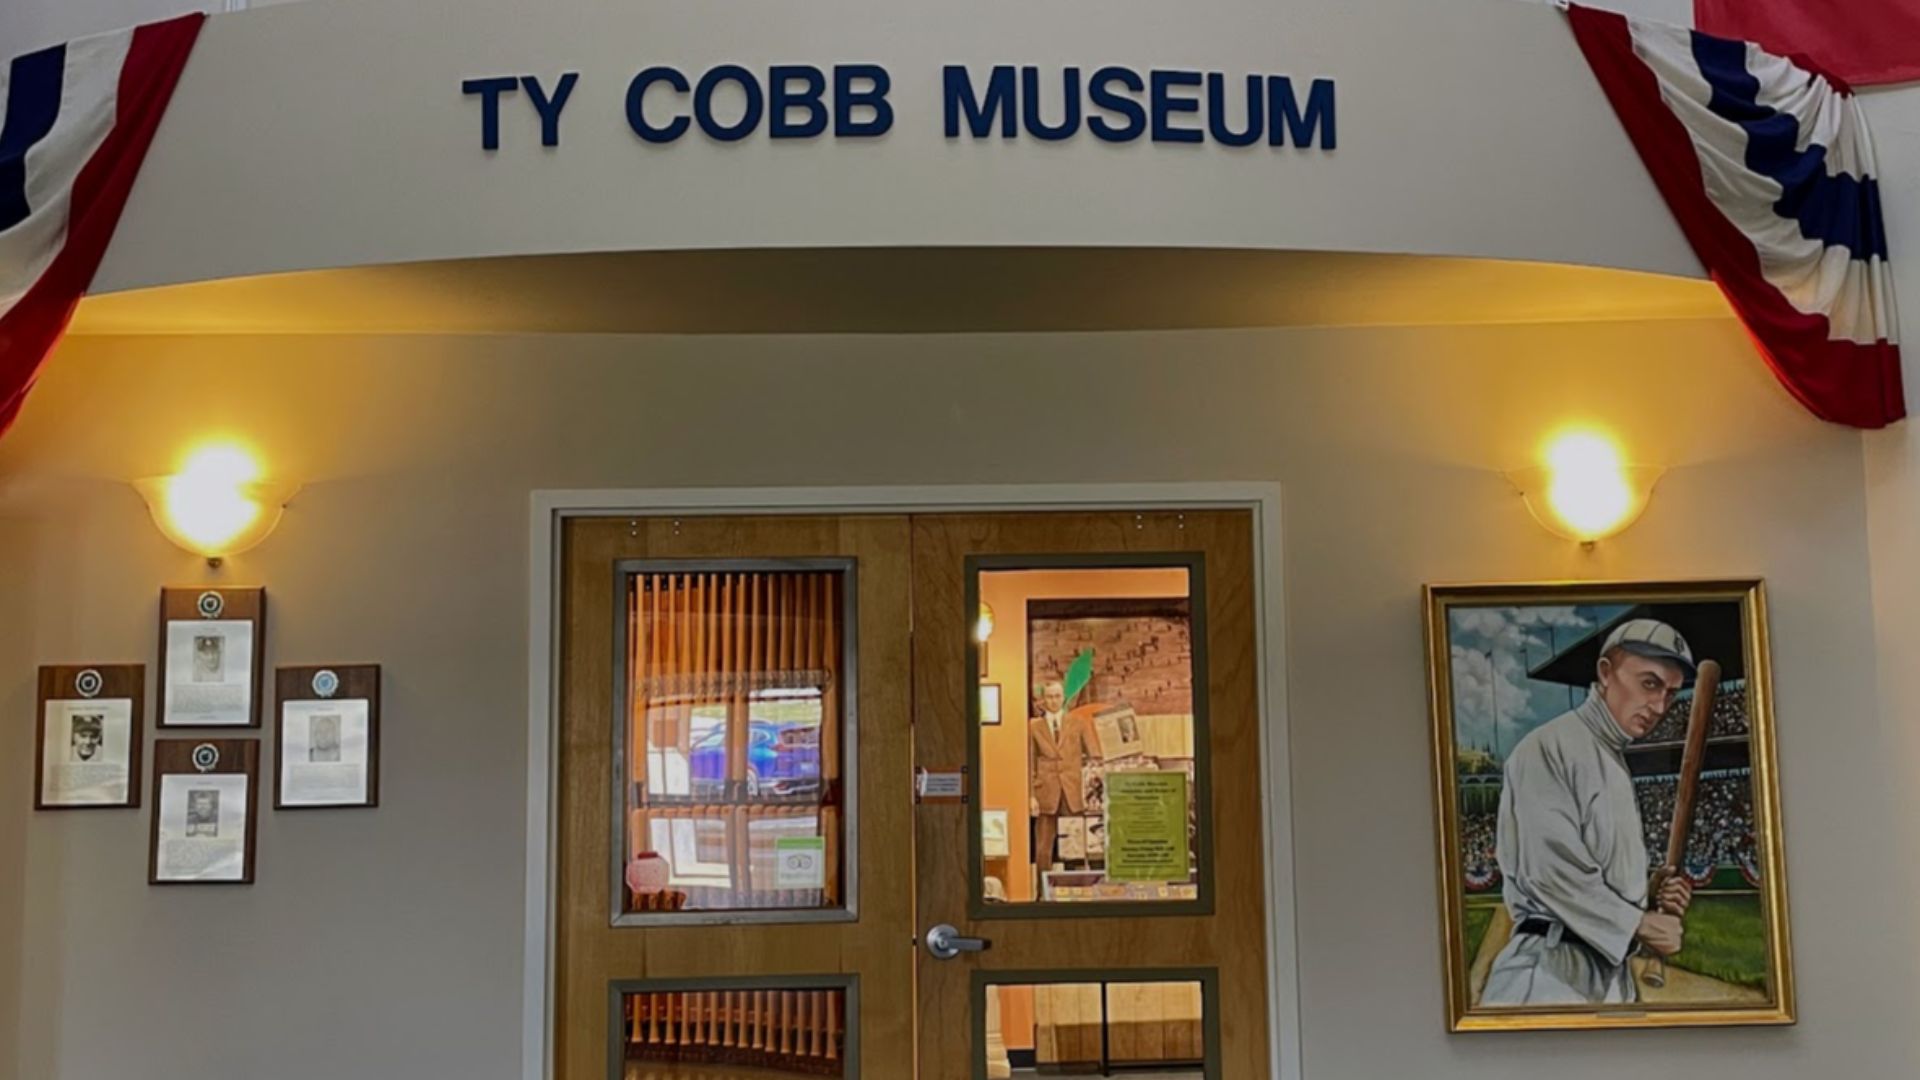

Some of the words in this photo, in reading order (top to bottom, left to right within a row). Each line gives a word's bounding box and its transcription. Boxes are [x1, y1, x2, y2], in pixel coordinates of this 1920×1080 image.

[462, 72, 580, 150] TY
[625, 64, 895, 144] COBB
[943, 65, 1337, 150] MUSEUM
